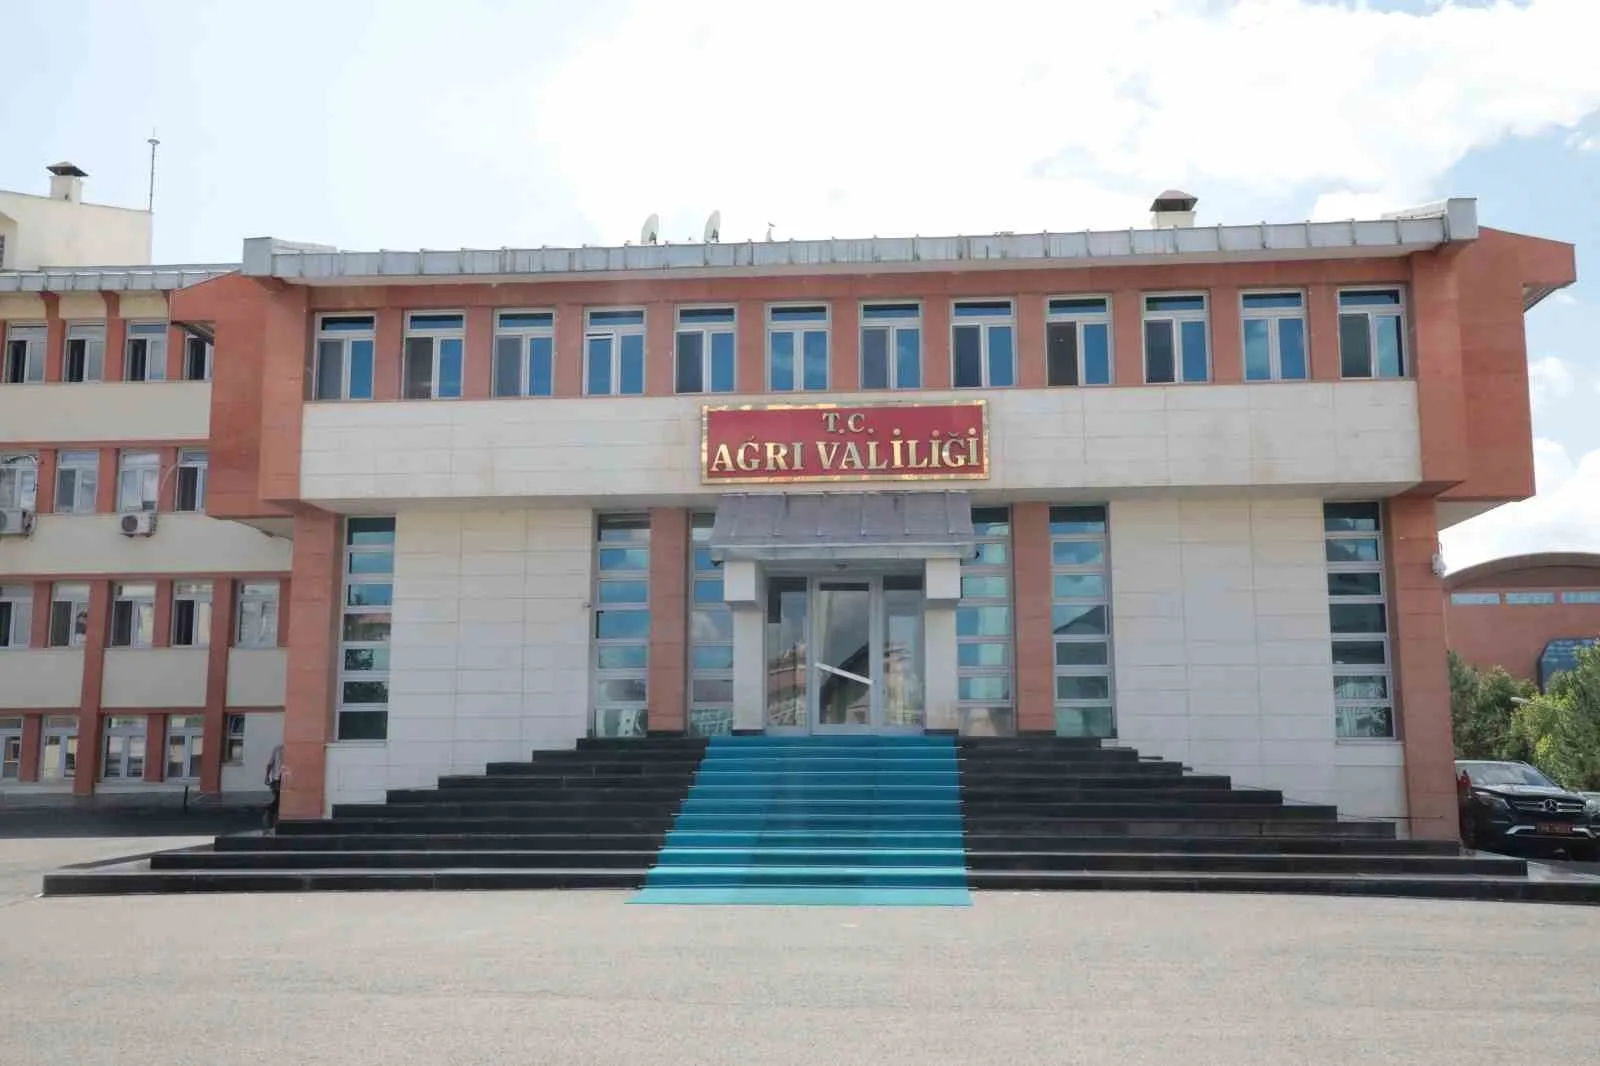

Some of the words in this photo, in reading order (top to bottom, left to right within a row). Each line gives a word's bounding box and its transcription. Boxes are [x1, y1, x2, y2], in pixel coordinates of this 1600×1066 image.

[822, 412, 875, 434] T.C.
[710, 436, 805, 472] AĞRI
[815, 427, 980, 471] VALİLİĞİ
